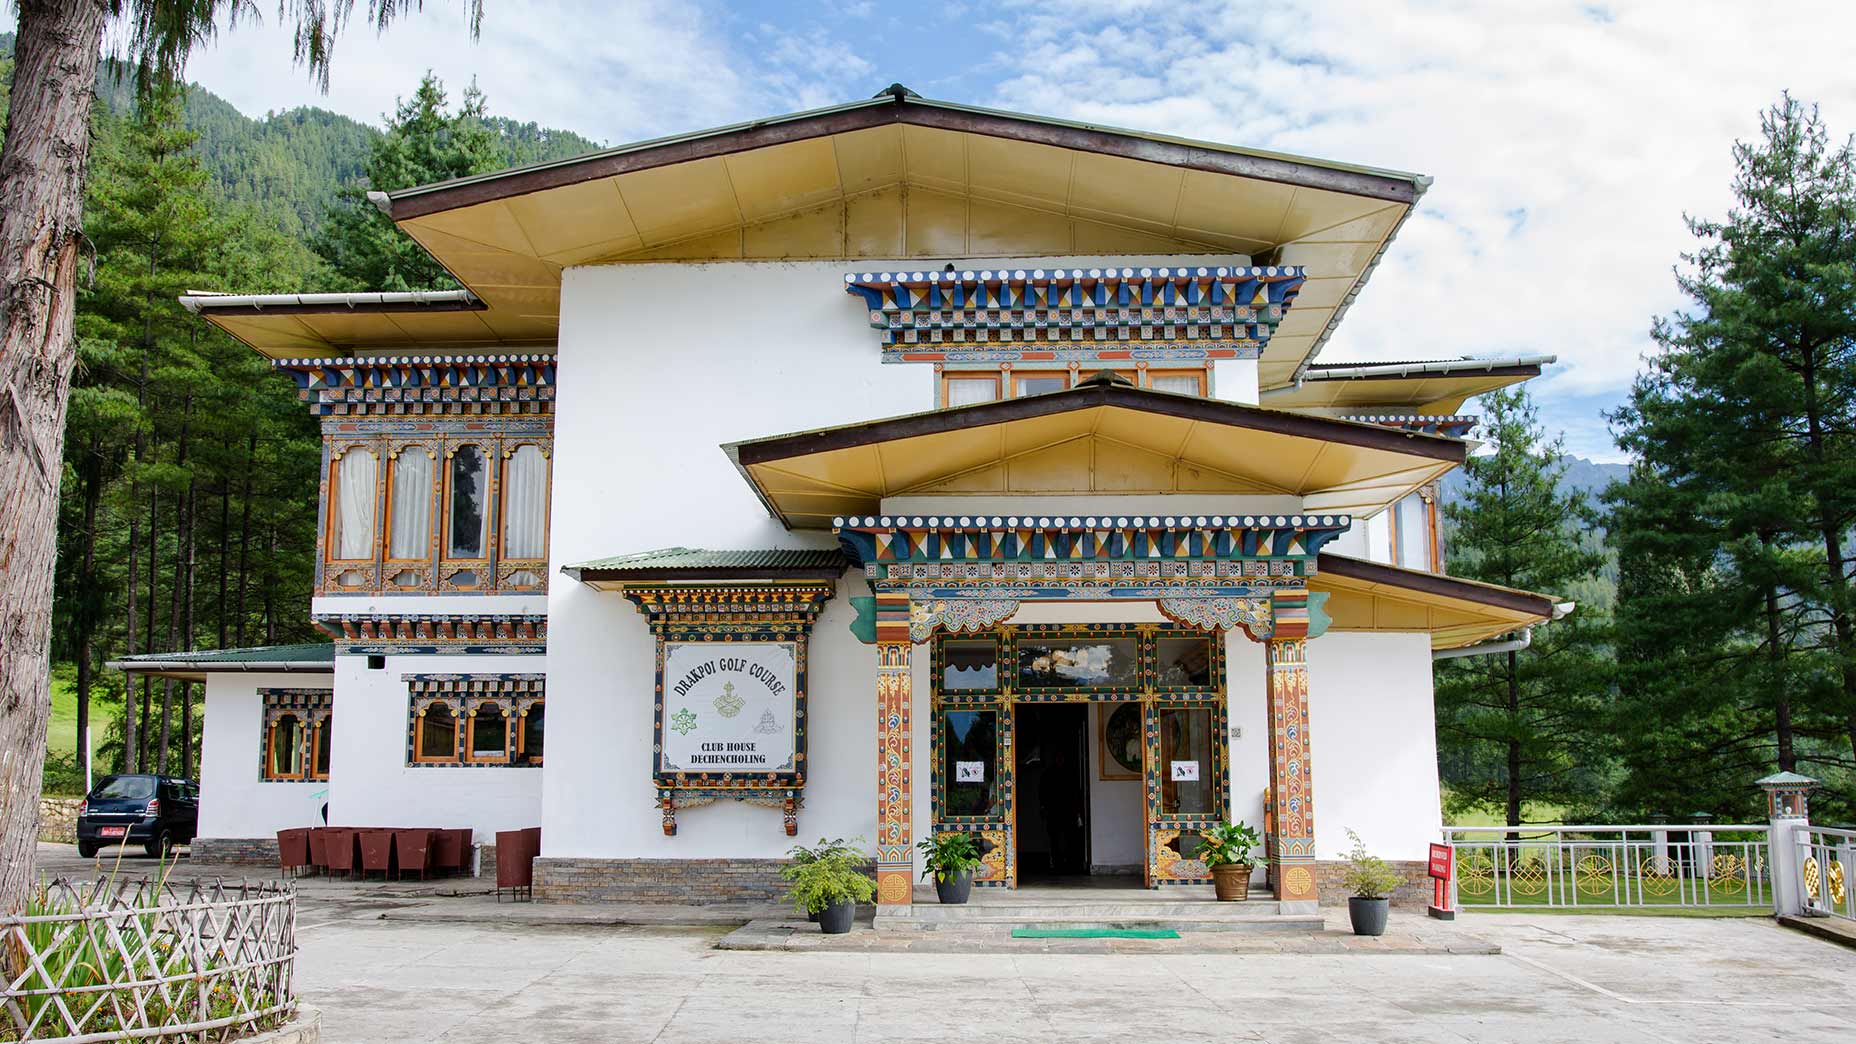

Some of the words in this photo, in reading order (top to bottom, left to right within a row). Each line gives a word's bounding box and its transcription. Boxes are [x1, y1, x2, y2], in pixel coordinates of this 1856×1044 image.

[674, 661, 716, 696] DRAKPOI
[719, 658, 747, 672] GOLF
[749, 663, 786, 696] COURSE
[701, 742, 724, 752] CLUB
[727, 742, 756, 752] HOUSE
[691, 754, 766, 764] DECHENCHOLING
